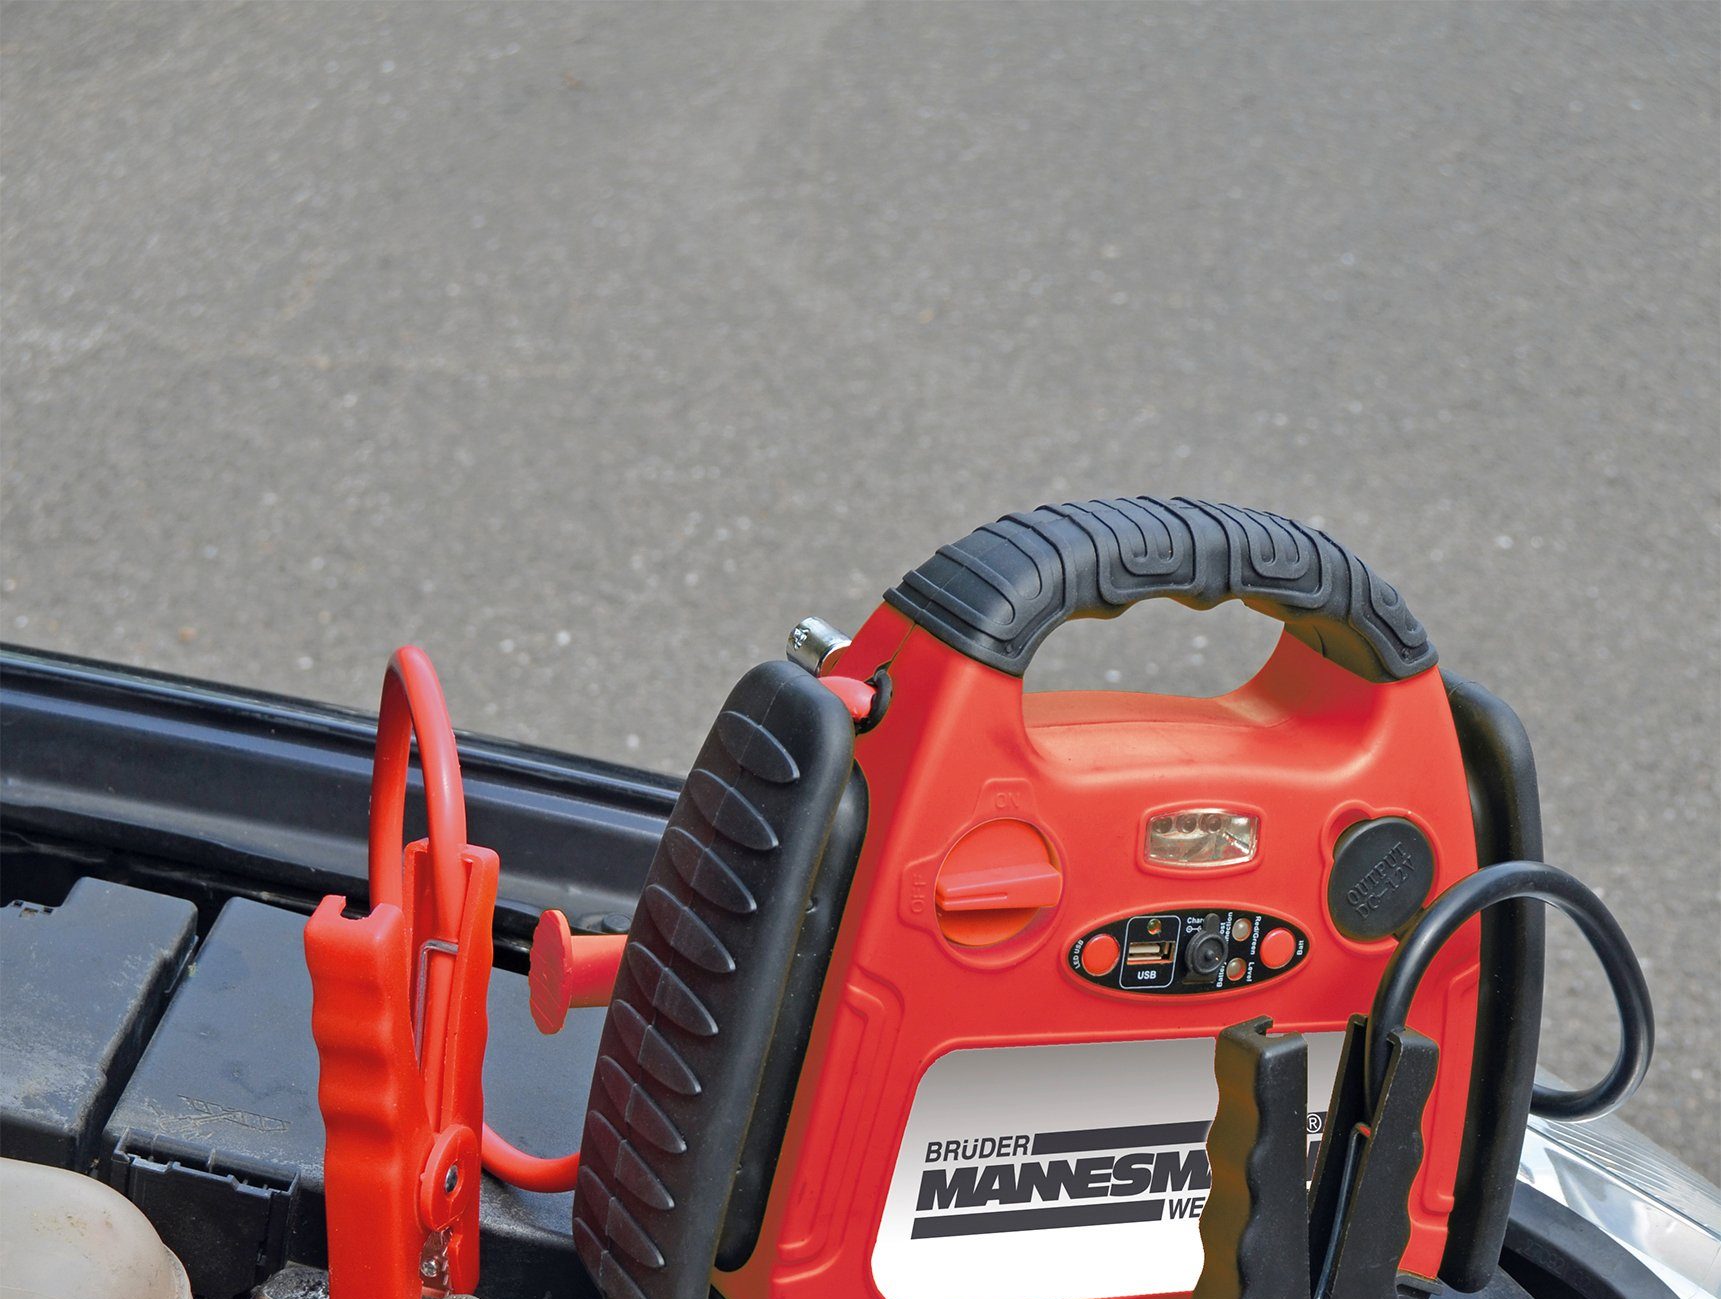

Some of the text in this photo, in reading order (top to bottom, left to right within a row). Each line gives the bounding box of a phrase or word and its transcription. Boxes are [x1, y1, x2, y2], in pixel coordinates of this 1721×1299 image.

[995, 792, 1020, 809] ON
[1346, 841, 1407, 905] OUTPUT
[911, 873, 927, 913] OFF
[1186, 916, 1204, 924] Char
[1296, 940, 1305, 956] Batt
[1137, 970, 1157, 980] USB
[1246, 961, 1255, 982] Level
[915, 1148, 1213, 1212] MANNESM
